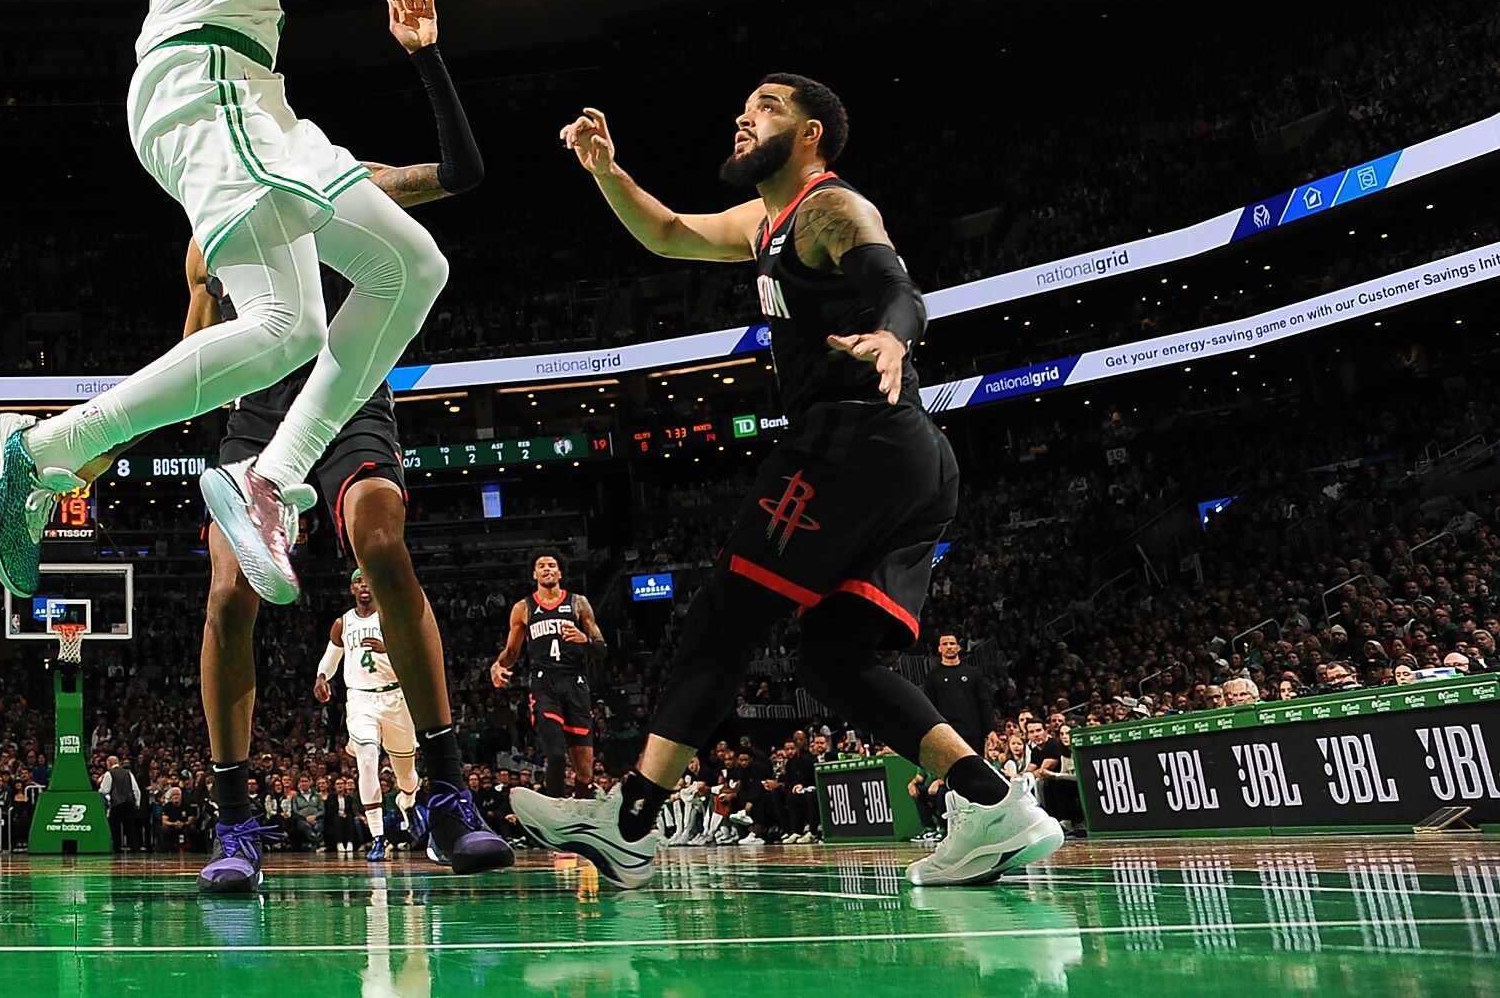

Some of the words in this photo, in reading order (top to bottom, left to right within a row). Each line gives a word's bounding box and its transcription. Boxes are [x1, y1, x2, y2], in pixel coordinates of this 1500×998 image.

[1036, 250, 1129, 286] nationalgrid
[1105, 354, 1128, 368] Get
[1130, 350, 1159, 366] your
[1161, 328, 1253, 359] energy-saving
[1255, 318, 1287, 339] game
[1289, 315, 1304, 327] on
[1307, 303, 1333, 324] with
[1335, 301, 1355, 314] our
[1358, 277, 1420, 306] Customer
[1423, 261, 1476, 288] Savings
[535, 353, 621, 374] nationalgrid
[985, 366, 1060, 394] nationalgrid
[735, 418, 754, 434] TD
[761, 415, 789, 429] Bank
[522, 449, 530, 459] 2
[593, 439, 606, 451] 19
[402, 457, 421, 469] 0/3
[443, 455, 450, 465] 1
[468, 453, 476, 464] 2
[496, 450, 502, 461] 1
[116, 458, 131, 478] 8
[153, 458, 205, 476] BOSTON
[55, 529, 94, 538] TISSOT
[550, 639, 561, 661] 4
[360, 651, 377, 674] 4
[59, 735, 80, 745] VISTA
[59, 745, 80, 754] PRINT
[1092, 755, 1147, 814] JBL
[1159, 749, 1218, 811] JBL
[1233, 741, 1302, 807] JBL
[1317, 731, 1399, 804] JBL
[1416, 723, 1500, 800] JBL
[828, 782, 856, 826] JBL
[863, 780, 893, 824] JBL
[46, 824, 61, 832] new
[61, 823, 92, 832] balance
